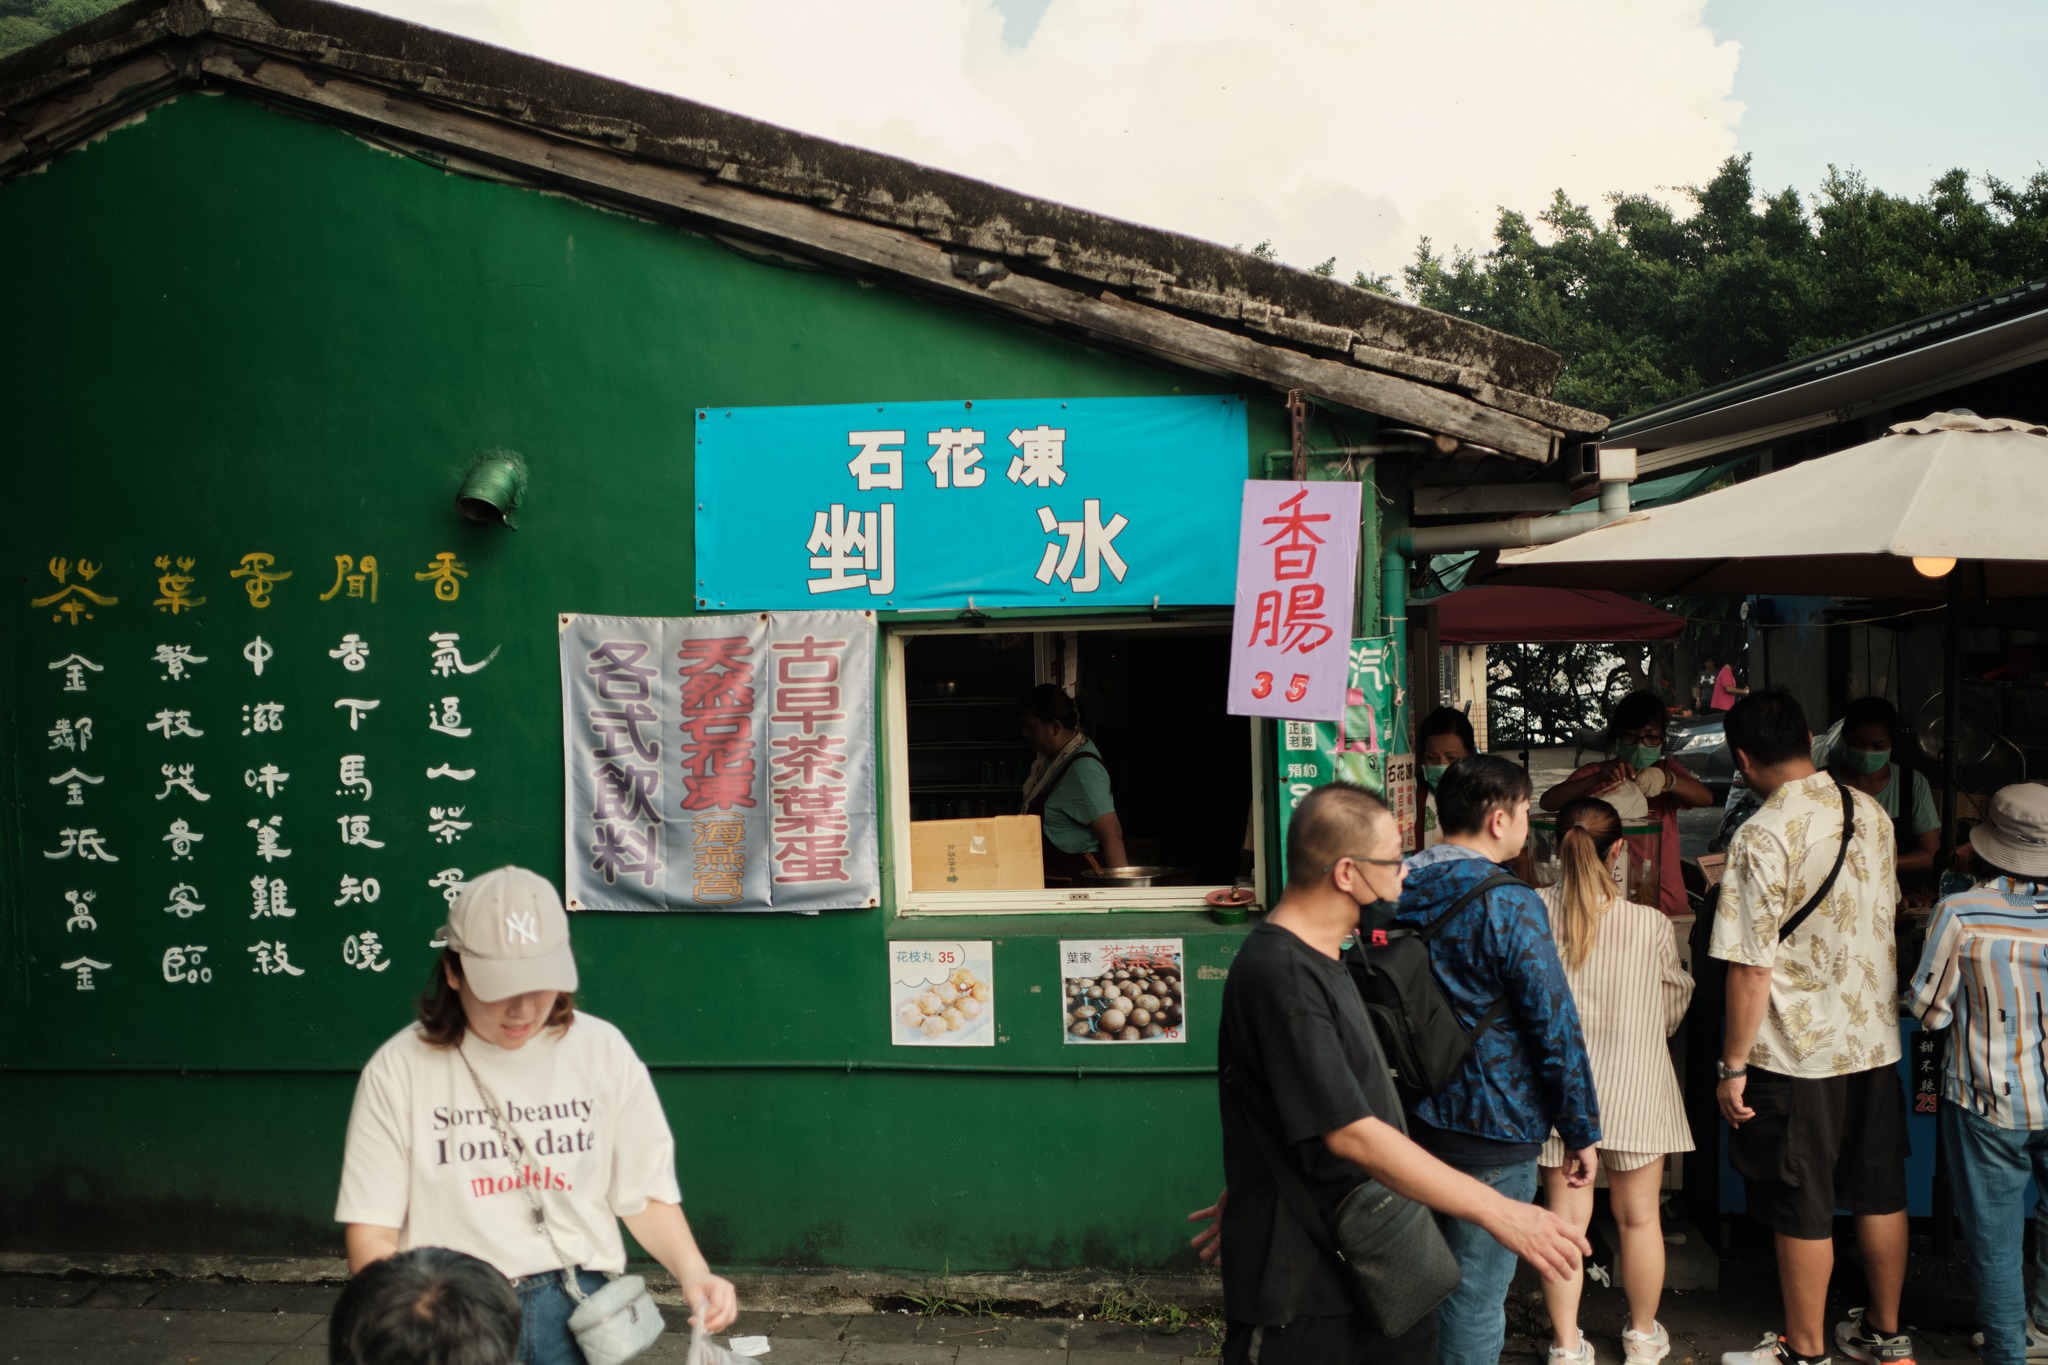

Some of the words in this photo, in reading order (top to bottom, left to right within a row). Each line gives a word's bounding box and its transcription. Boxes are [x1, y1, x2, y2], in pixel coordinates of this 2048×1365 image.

[847, 425, 1067, 491] 石花凍
[806, 499, 1129, 595] 剉冰
[1247, 488, 1334, 655] 香腸
[1251, 671, 1311, 704] 35
[678, 636, 757, 811] 天然石花凍
[588, 641, 662, 886] 各式飲料
[771, 635, 850, 883] 古早茶葉蛋
[1287, 763, 1317, 778] 預約
[896, 950, 934, 964] 花枝丸
[938, 951, 955, 964] 35
[1066, 951, 1092, 965] 葉家
[1099, 944, 1177, 969] 茶葉蛋
[1163, 1026, 1179, 1039] 15
[1918, 1040, 1936, 1093] 甜不辣
[433, 1107, 500, 1131] Sorry
[506, 1098, 593, 1122] beauty
[436, 1138, 450, 1166] I
[459, 1136, 525, 1166] only
[535, 1128, 595, 1156] date
[470, 1164, 572, 1198] models.
